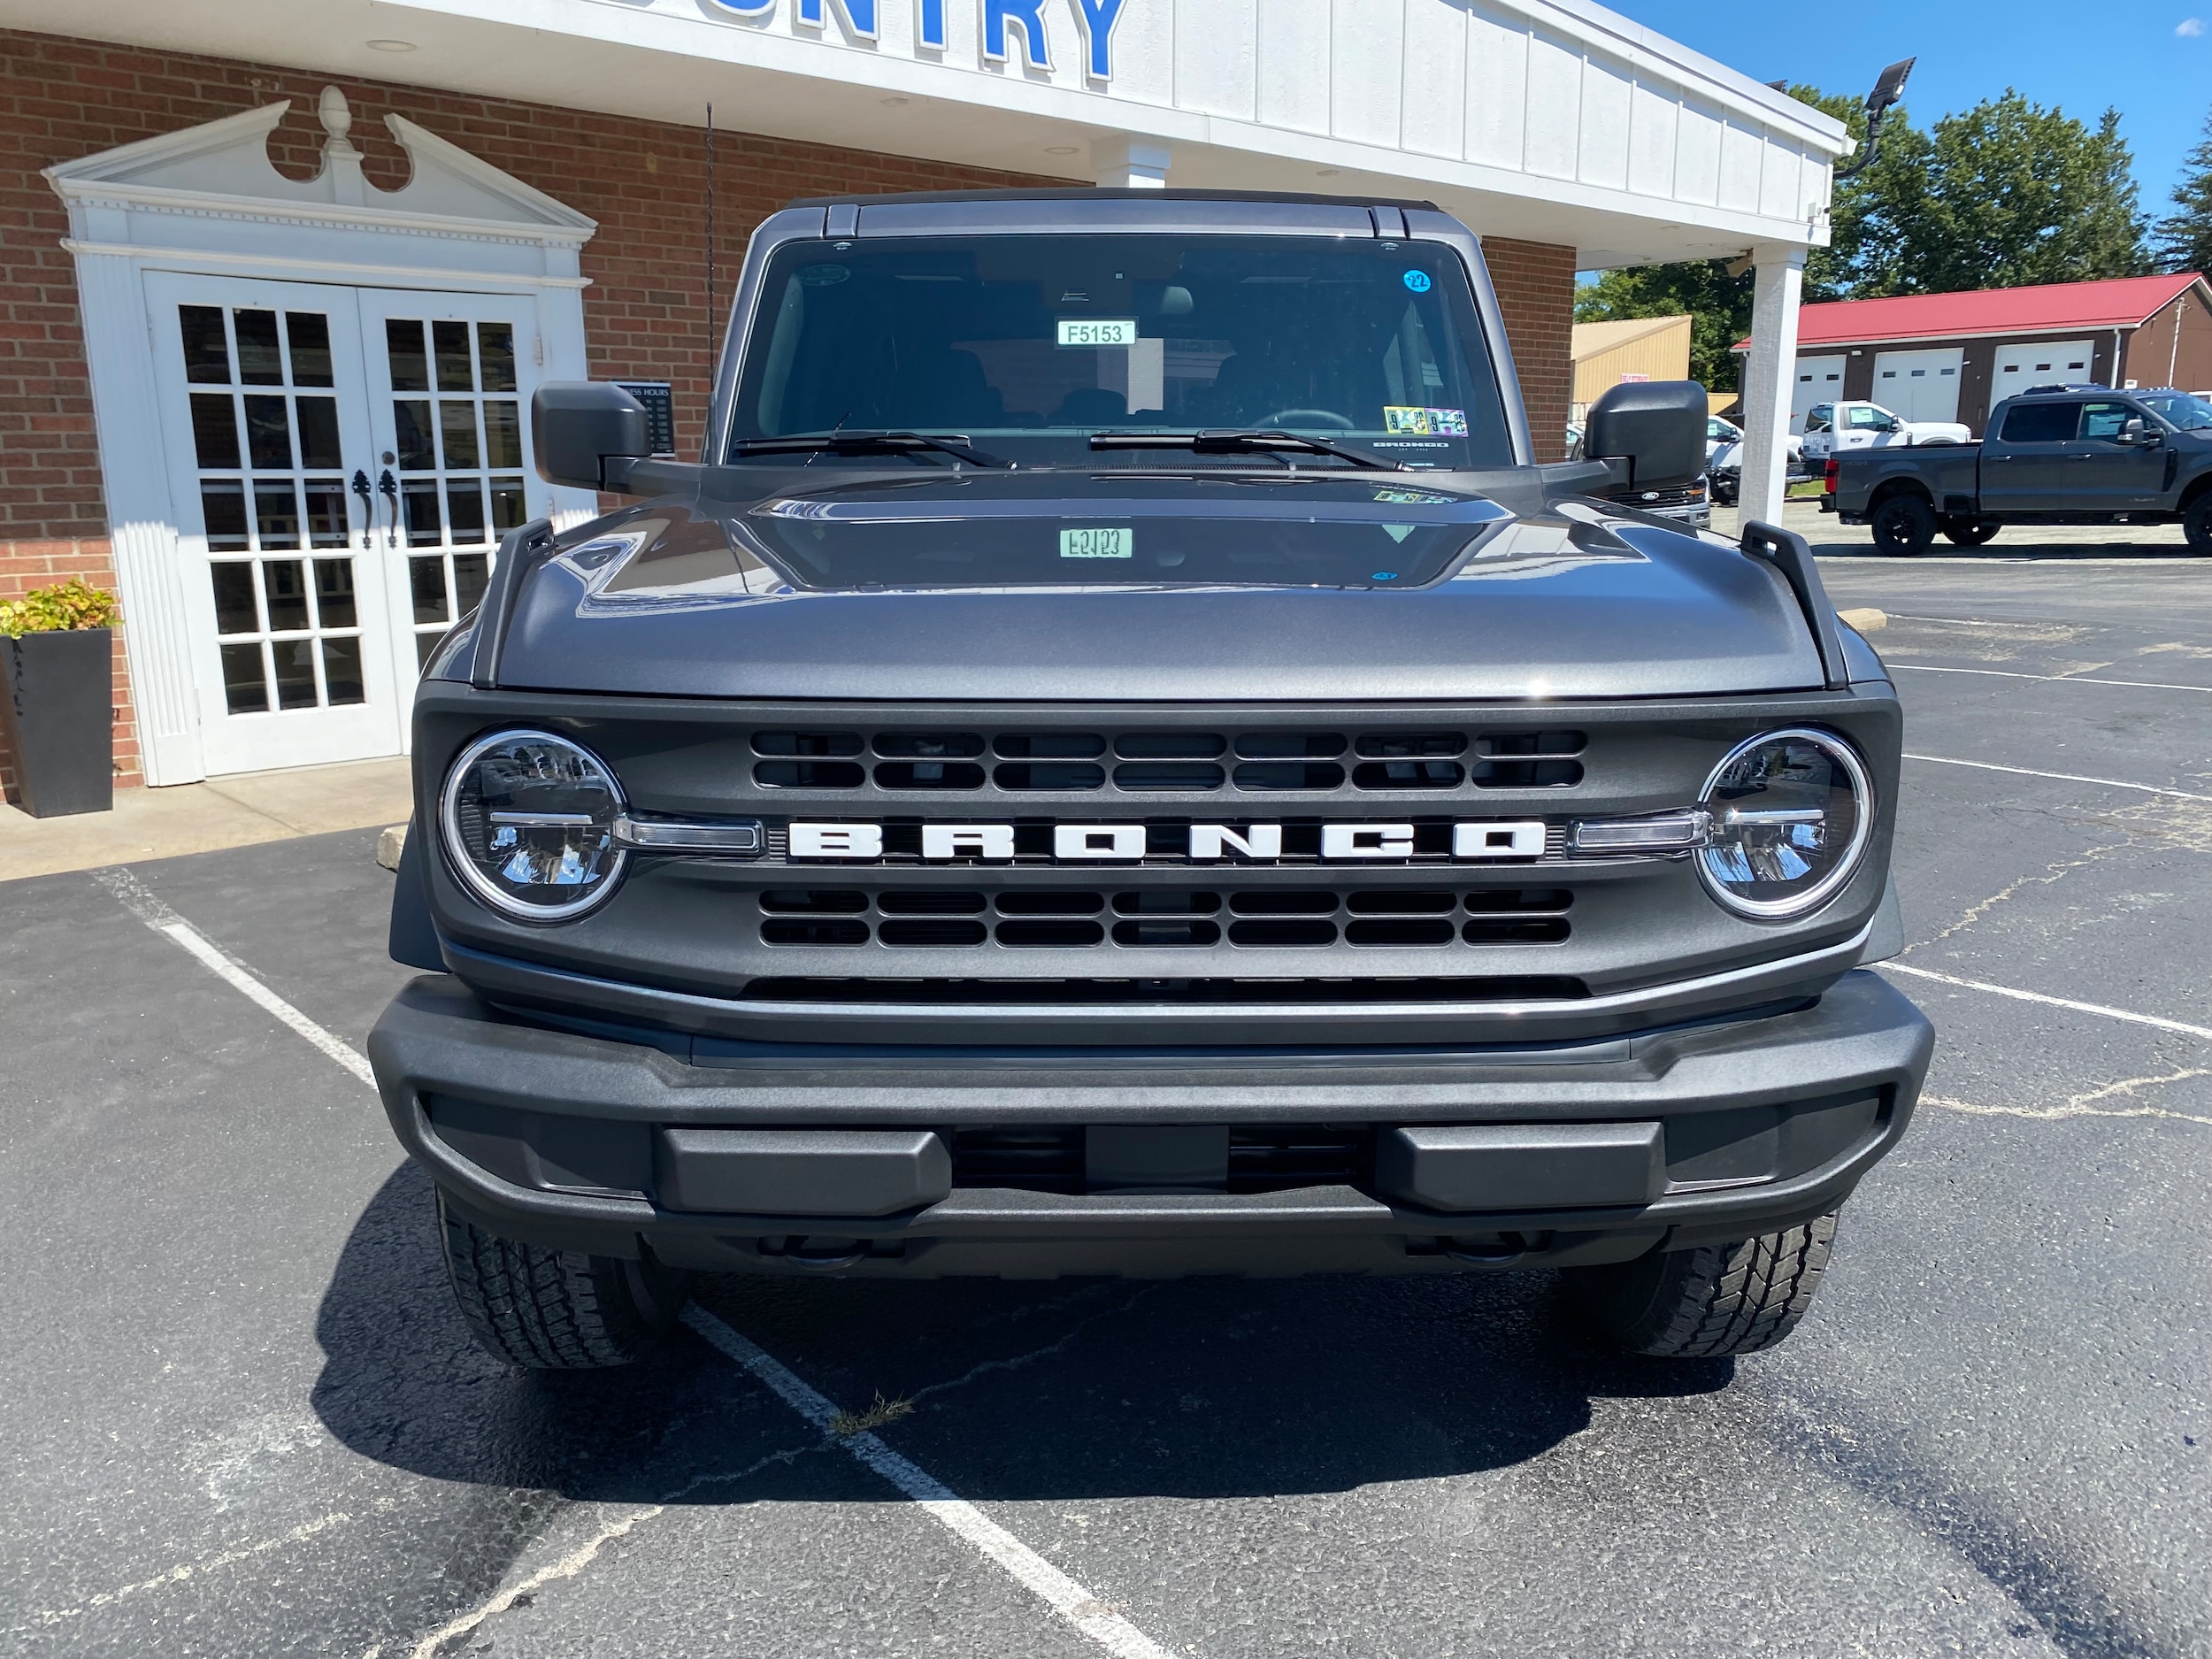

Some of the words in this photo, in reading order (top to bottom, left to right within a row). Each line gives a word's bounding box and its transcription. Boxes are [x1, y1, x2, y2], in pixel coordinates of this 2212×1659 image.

[1408, 274, 1428, 288] 22
[1068, 326, 1122, 342] F5153
[788, 822, 1547, 859] BRONCO
